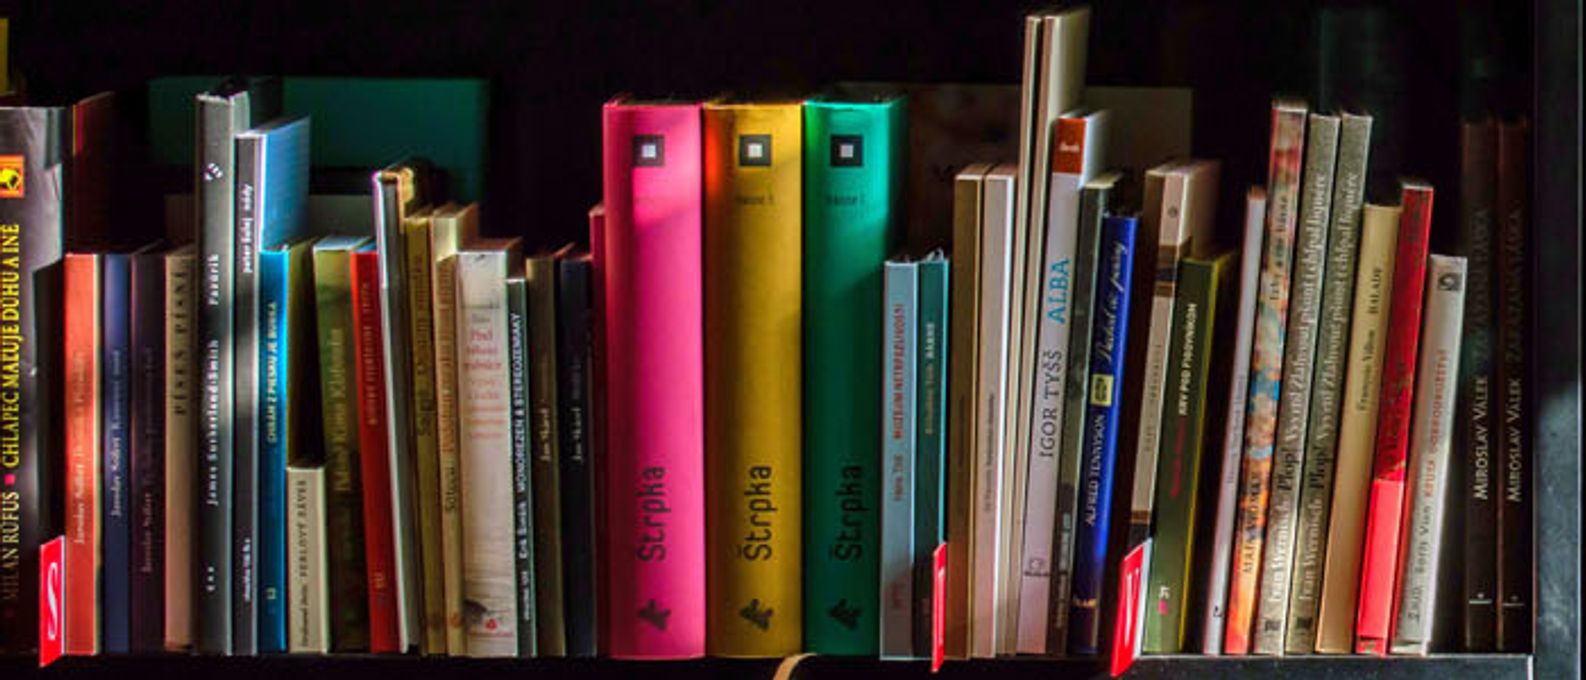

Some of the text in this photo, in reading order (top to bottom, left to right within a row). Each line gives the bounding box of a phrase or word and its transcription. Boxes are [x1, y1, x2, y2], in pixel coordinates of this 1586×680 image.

[1040, 258, 1070, 457] IGOR TYŠŠ ALBA
[1361, 329, 1375, 361] Villon
[1179, 370, 1192, 391] POD
[1469, 376, 1488, 418] VÁLEK
[1503, 378, 1522, 420] VÁLEK
[0, 225, 21, 600] MILAN RÚFUS CHLAPEC MAĽUJE DÚHU A INÉ
[1177, 394, 1189, 415] KRV
[1087, 415, 1105, 479] TENNYSON
[1310, 446, 1333, 489] Plop!
[1471, 427, 1489, 499] MIROSLAV
[1505, 426, 1522, 501] MIROSLAV
[206, 466, 219, 507] James
[1276, 448, 1298, 492] Plop!
[733, 465, 777, 561] Štrpka
[828, 465, 868, 561] Štrpka
[1084, 482, 1098, 526] ALFRED
[1418, 506, 1431, 536] Vian
[1271, 500, 1290, 569] Wernisch
[1303, 499, 1322, 568] Wernisch
[1269, 571, 1282, 602] Ivan
[1299, 571, 1315, 600] Ivan
